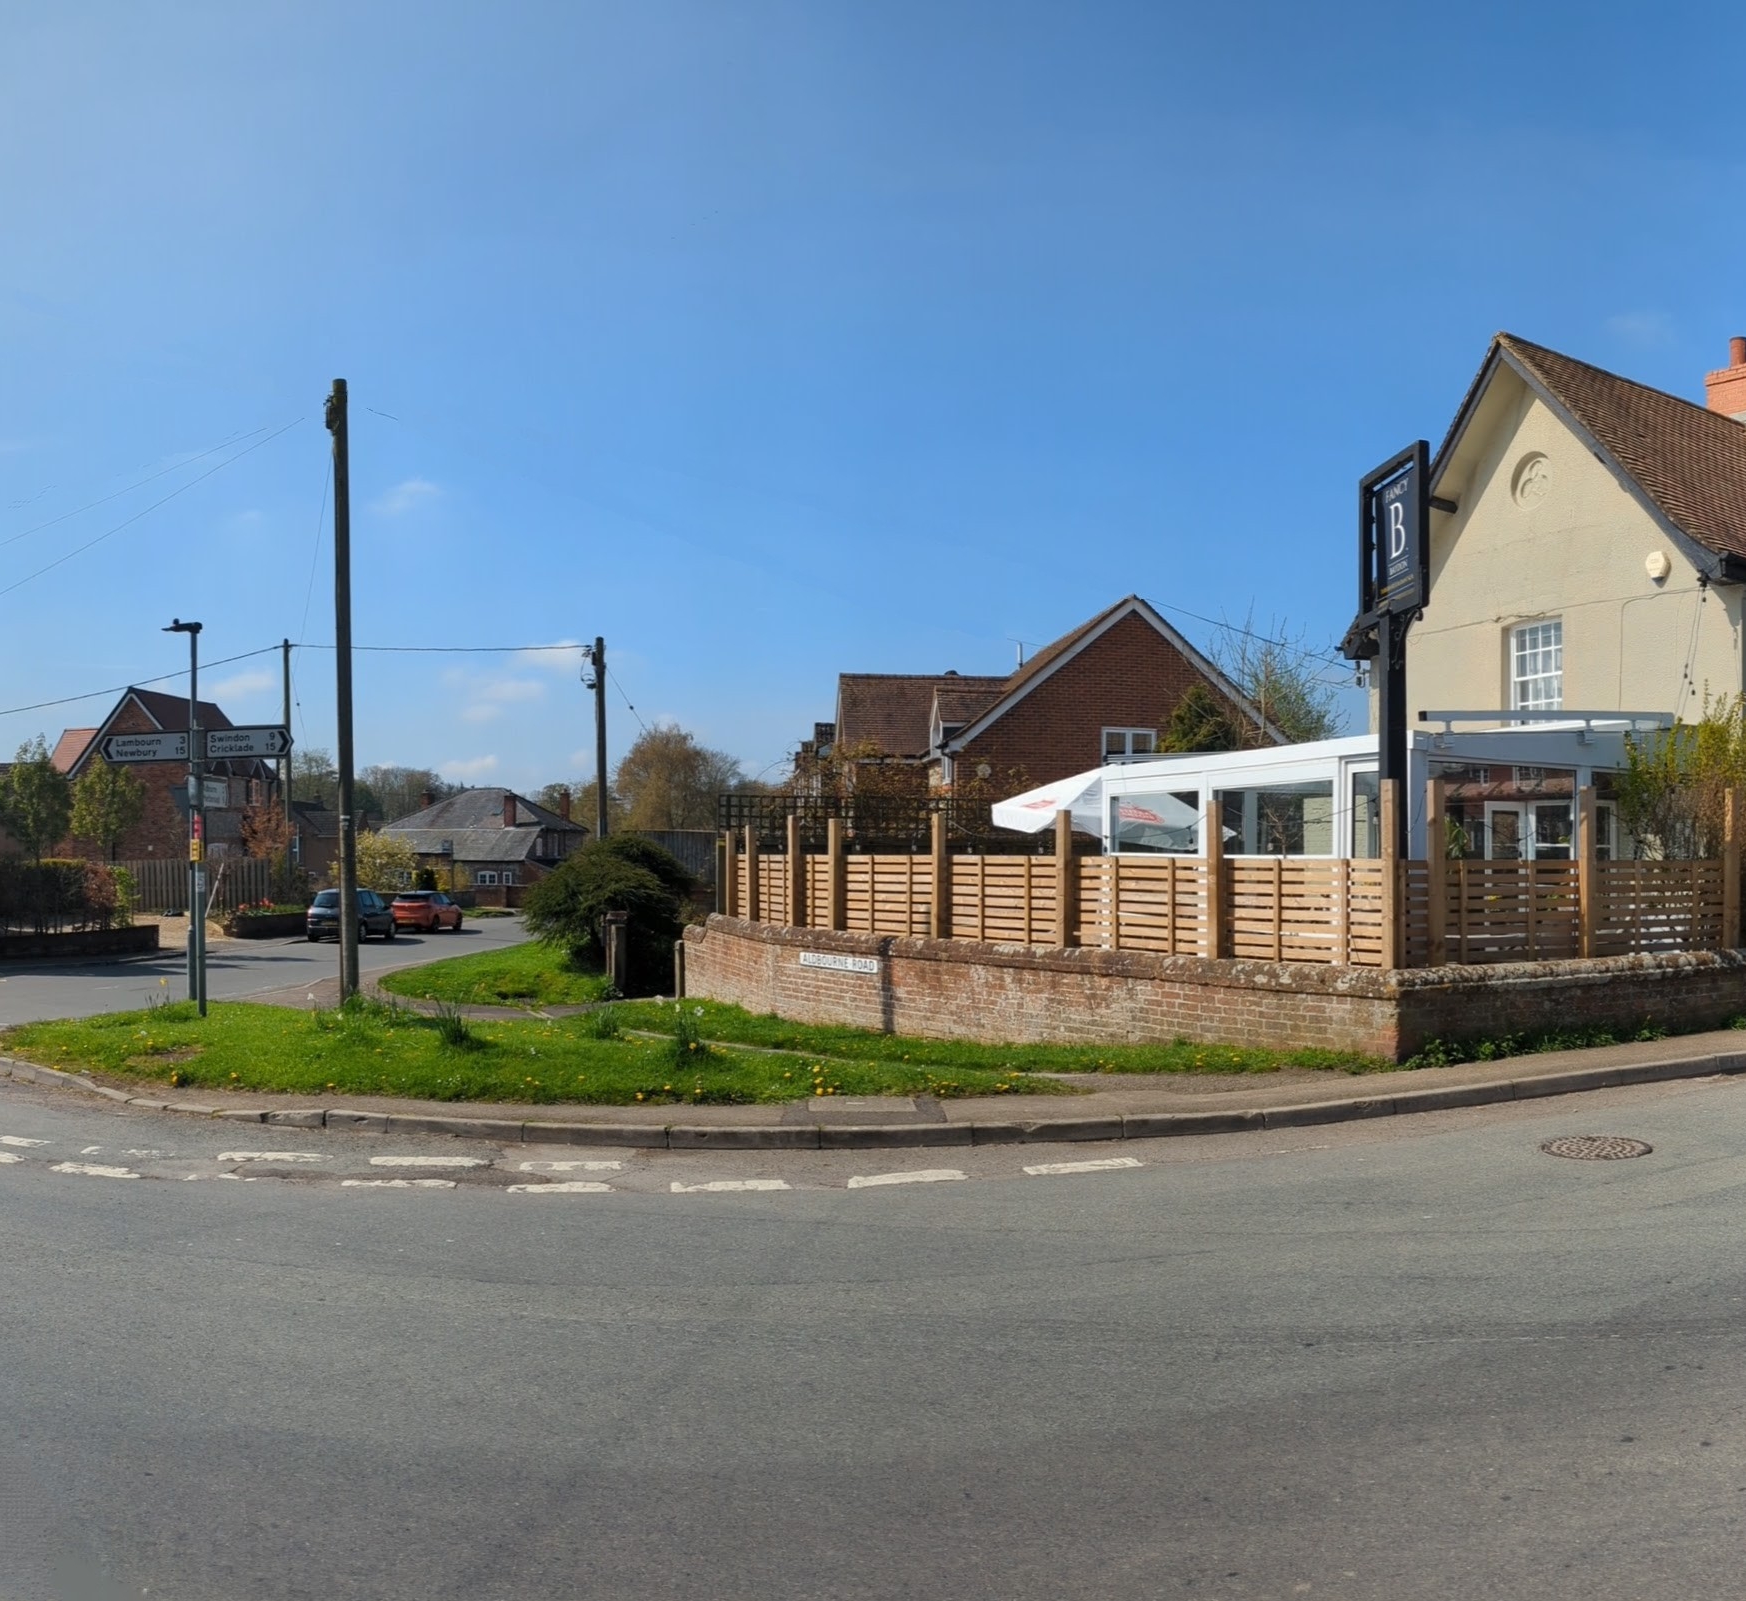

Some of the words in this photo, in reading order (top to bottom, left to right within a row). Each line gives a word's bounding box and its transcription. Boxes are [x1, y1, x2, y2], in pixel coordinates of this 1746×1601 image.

[1385, 477, 1409, 503] FANCY
[116, 738, 162, 747] Lambourn
[179, 736, 186, 744] 3
[210, 733, 250, 743] Swindon
[269, 732, 276, 741] 9
[116, 748, 158, 757] Newbury
[175, 746, 186, 755] 15
[210, 743, 254, 753] Cricklade
[265, 742, 276, 751] 15
[803, 953, 849, 969] ALDBOURNE
[852, 958, 876, 972] ROAD
